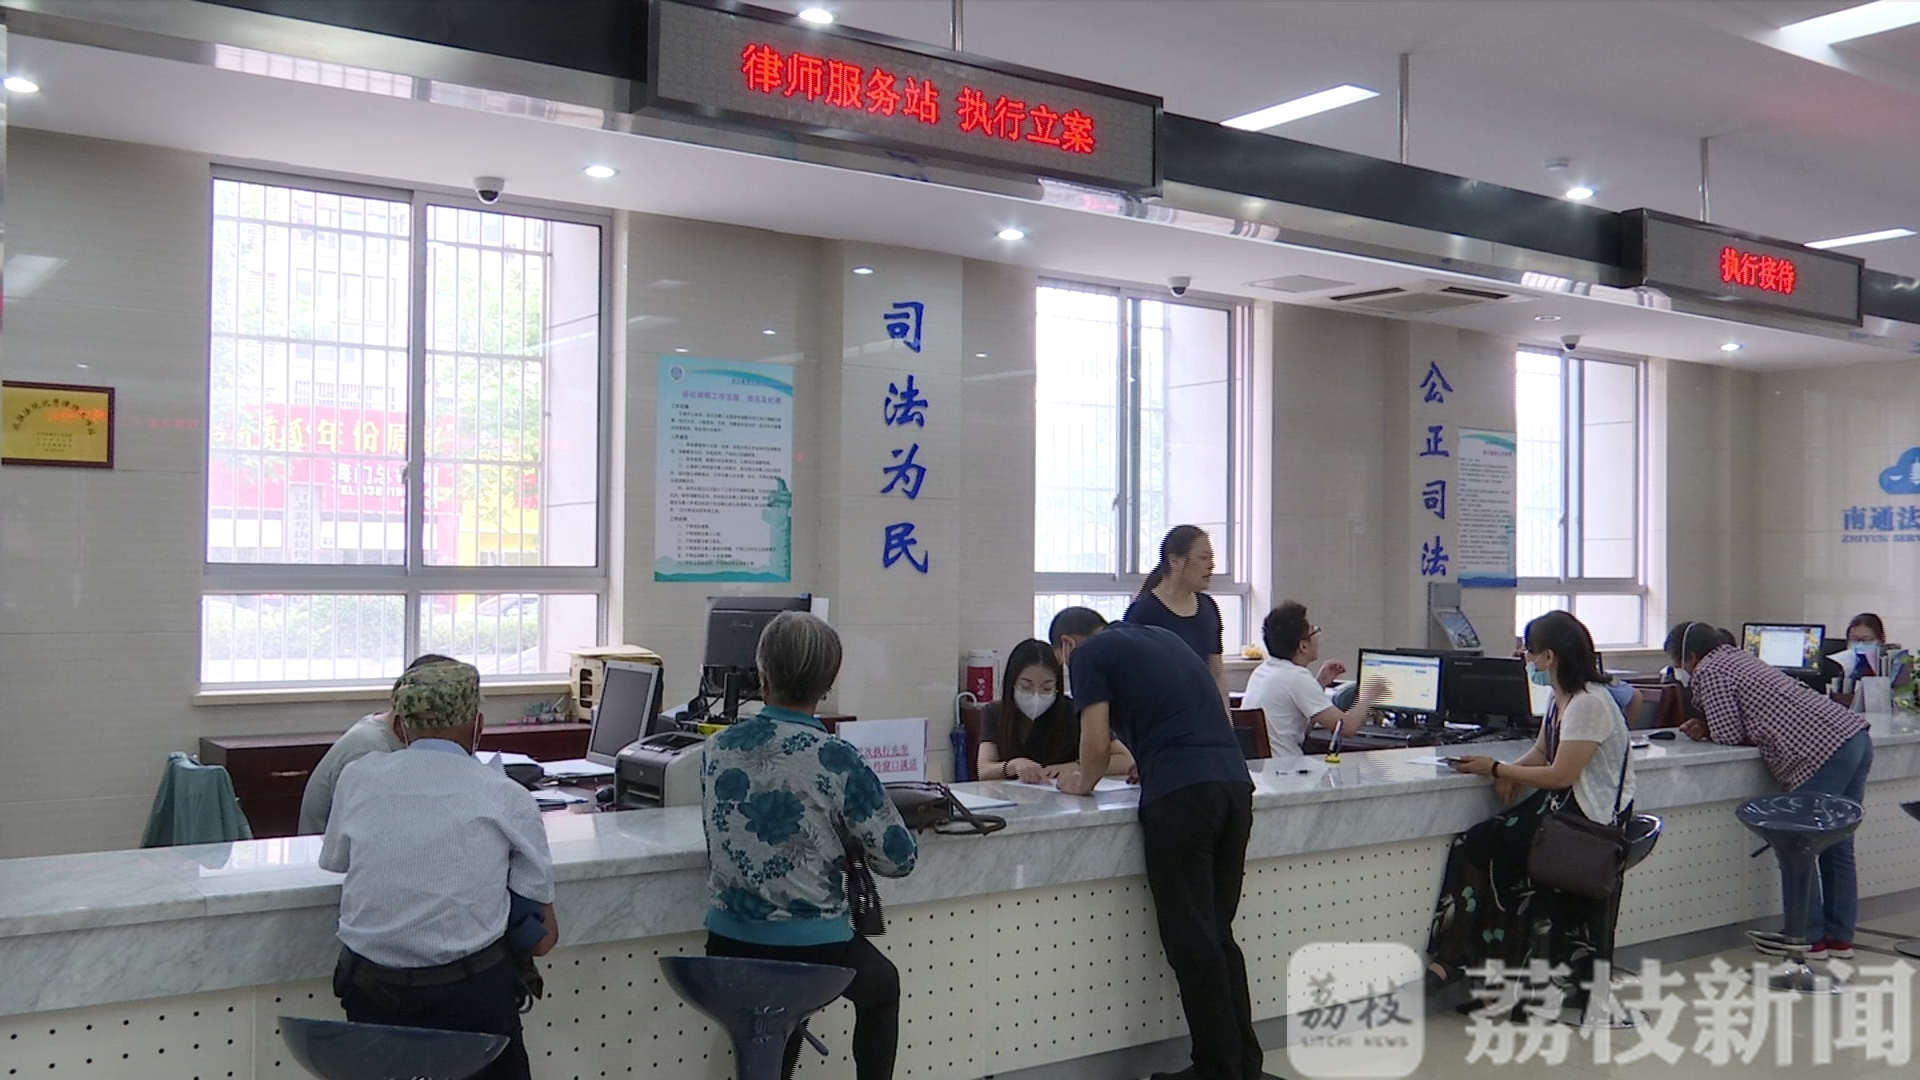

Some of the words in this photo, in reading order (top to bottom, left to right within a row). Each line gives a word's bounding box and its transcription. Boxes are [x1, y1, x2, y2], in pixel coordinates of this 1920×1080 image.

[741, 43, 939, 124] 律师服务站
[956, 87, 1097, 154] 执行立案
[1721, 247, 1796, 295] 执行接待
[880, 301, 929, 574] 司法为民
[1419, 361, 1454, 577] 公正司法
[1842, 505, 1920, 531] 南通法
